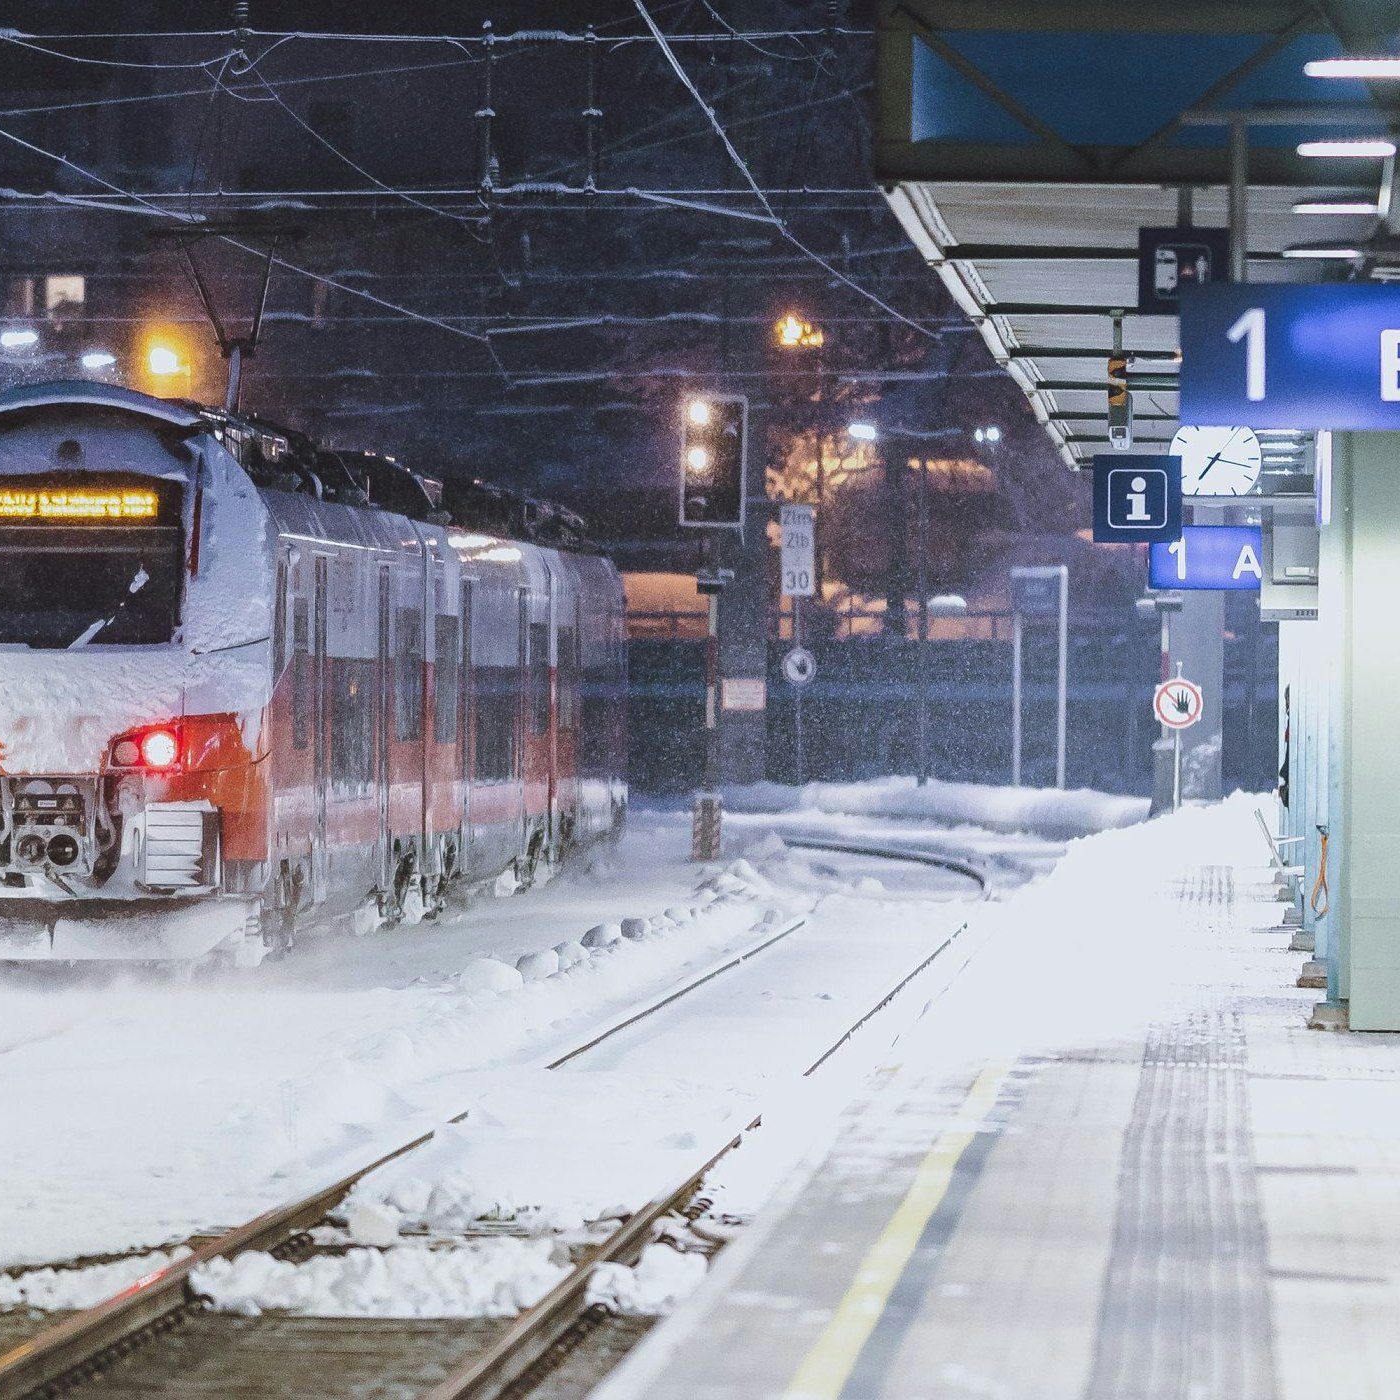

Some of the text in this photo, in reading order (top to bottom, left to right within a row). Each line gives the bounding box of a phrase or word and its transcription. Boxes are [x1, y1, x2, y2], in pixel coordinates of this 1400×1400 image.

[1226, 307, 1267, 402] 1
[785, 570, 809, 590] 30
[1168, 536, 1263, 580] 1 A
